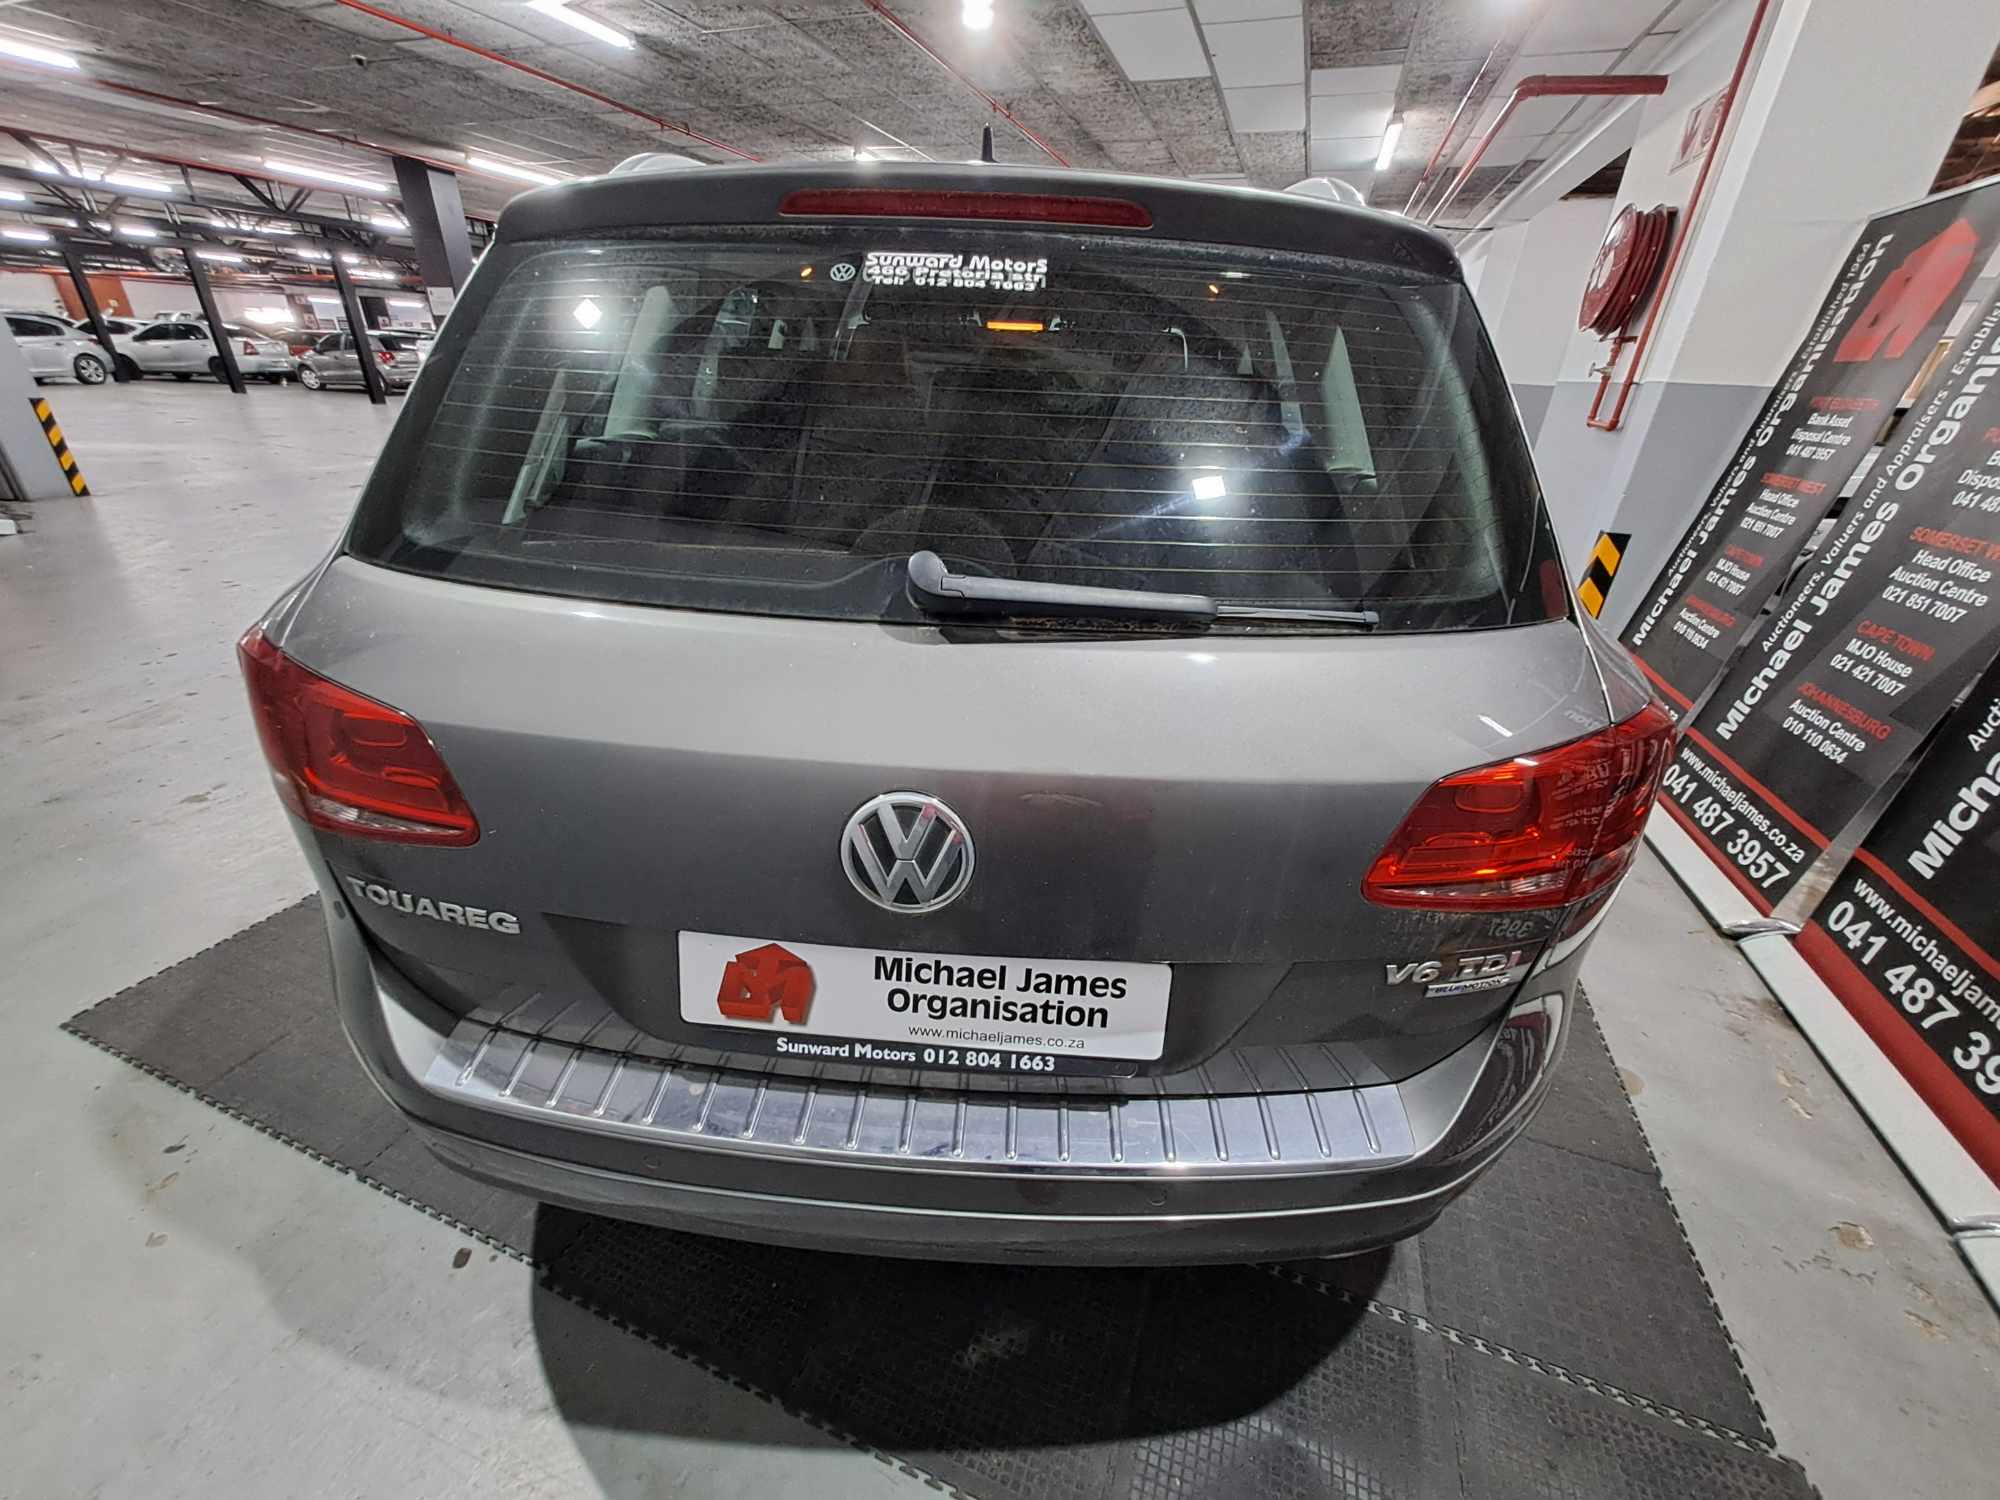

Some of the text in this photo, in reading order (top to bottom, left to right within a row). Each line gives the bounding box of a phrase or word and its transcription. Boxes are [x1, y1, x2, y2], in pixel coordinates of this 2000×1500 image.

[865, 252, 962, 269] Sunward
[1632, 549, 1698, 646] Michael
[1699, 455, 1757, 545] James
[1756, 233, 1894, 447] Organisation
[1761, 570, 1827, 653] Auctioneers,
[1820, 510, 1864, 566] Valuers
[1863, 477, 1888, 509] and
[1886, 389, 1949, 477] Appraisers
[1952, 302, 2000, 375] Establis
[1951, 491, 1983, 508] 041
[1889, 566, 1988, 607] Auction Centre
[1912, 549, 1992, 583] Head Office
[1716, 619, 1813, 740] Michael
[1810, 501, 1900, 616] James
[1882, 585, 1968, 622] 021 851 7007
[1856, 620, 1893, 646] CAPE
[1830, 653, 1906, 698] 021 421 7007
[1845, 638, 1913, 678] MJO House
[1782, 715, 1848, 765] 010 110 0634
[1789, 698, 1866, 752] Auction Centre
[1680, 747, 1805, 863] www.michaeljames.co.za
[1662, 764, 1791, 889] 041 487 3957
[346, 876, 521, 935] TOUAREG
[873, 955, 1128, 999] Michael James
[1385, 950, 1522, 985] V6 TDI
[1828, 901, 1888, 965] 041
[1884, 964, 1960, 1029] 487
[887, 988, 1110, 1029] Organisation
[776, 1037, 1056, 1072] Sunward Motors 012 804 1663
[908, 1025, 1086, 1050] www.michaeljames.co.za
